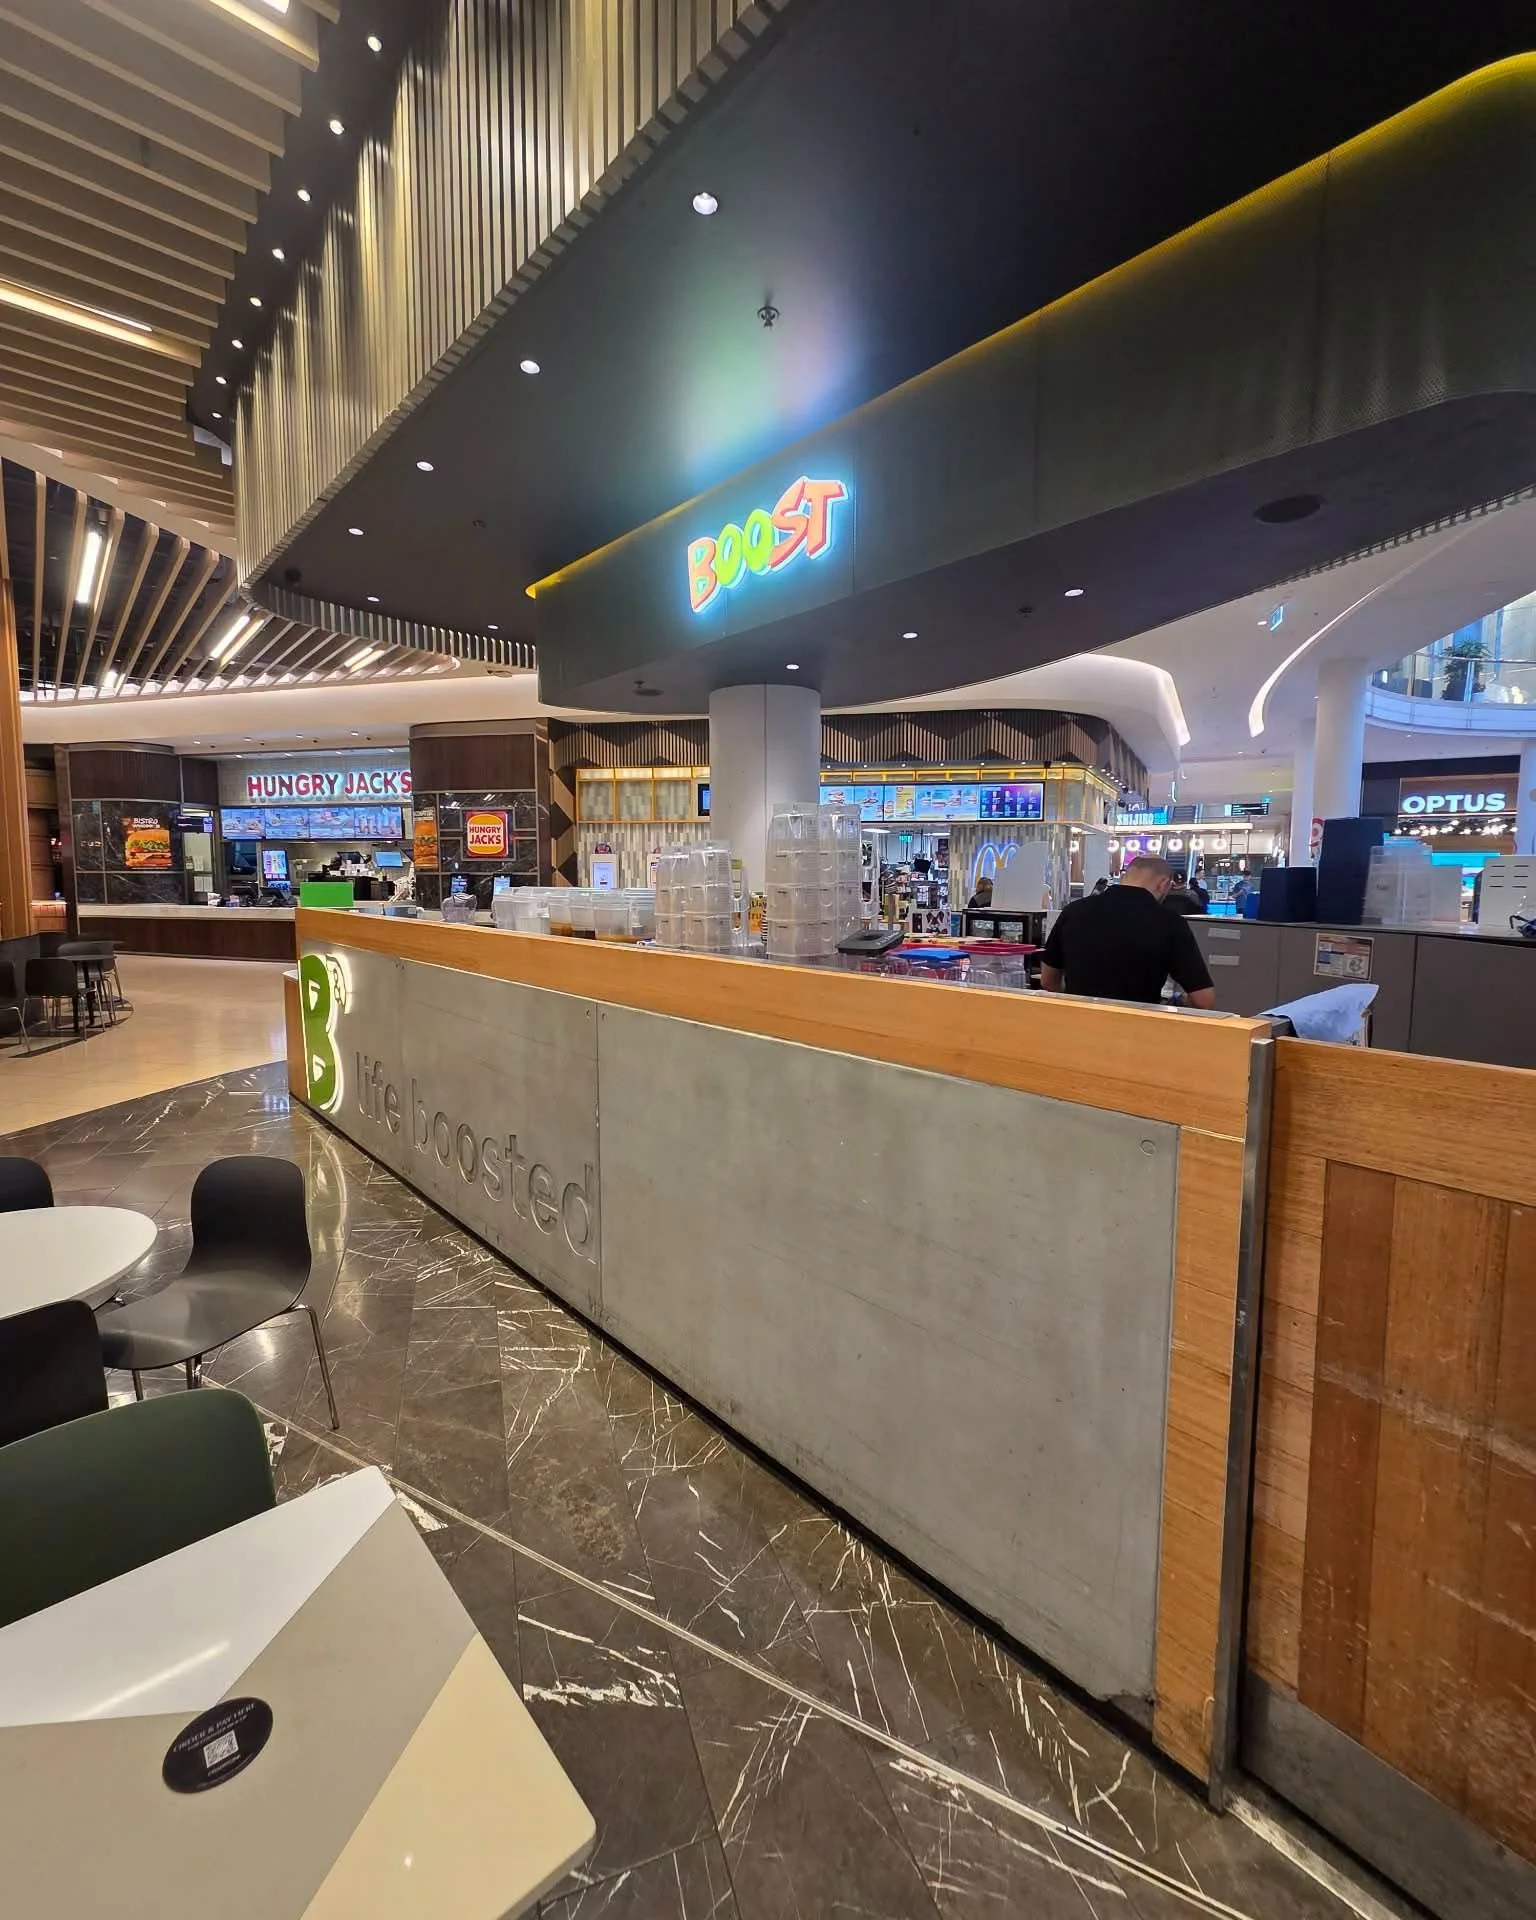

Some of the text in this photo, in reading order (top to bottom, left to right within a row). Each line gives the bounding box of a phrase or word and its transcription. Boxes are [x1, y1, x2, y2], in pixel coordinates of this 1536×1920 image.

[687, 475, 849, 613] BOOST
[247, 770, 413, 797] HUNGRY JACK'S
[1402, 793, 1505, 814] OPTUS
[469, 826, 501, 834] HUNGRY
[469, 834, 502, 845] JACK'S
[355, 1052, 597, 1265] life boosted
